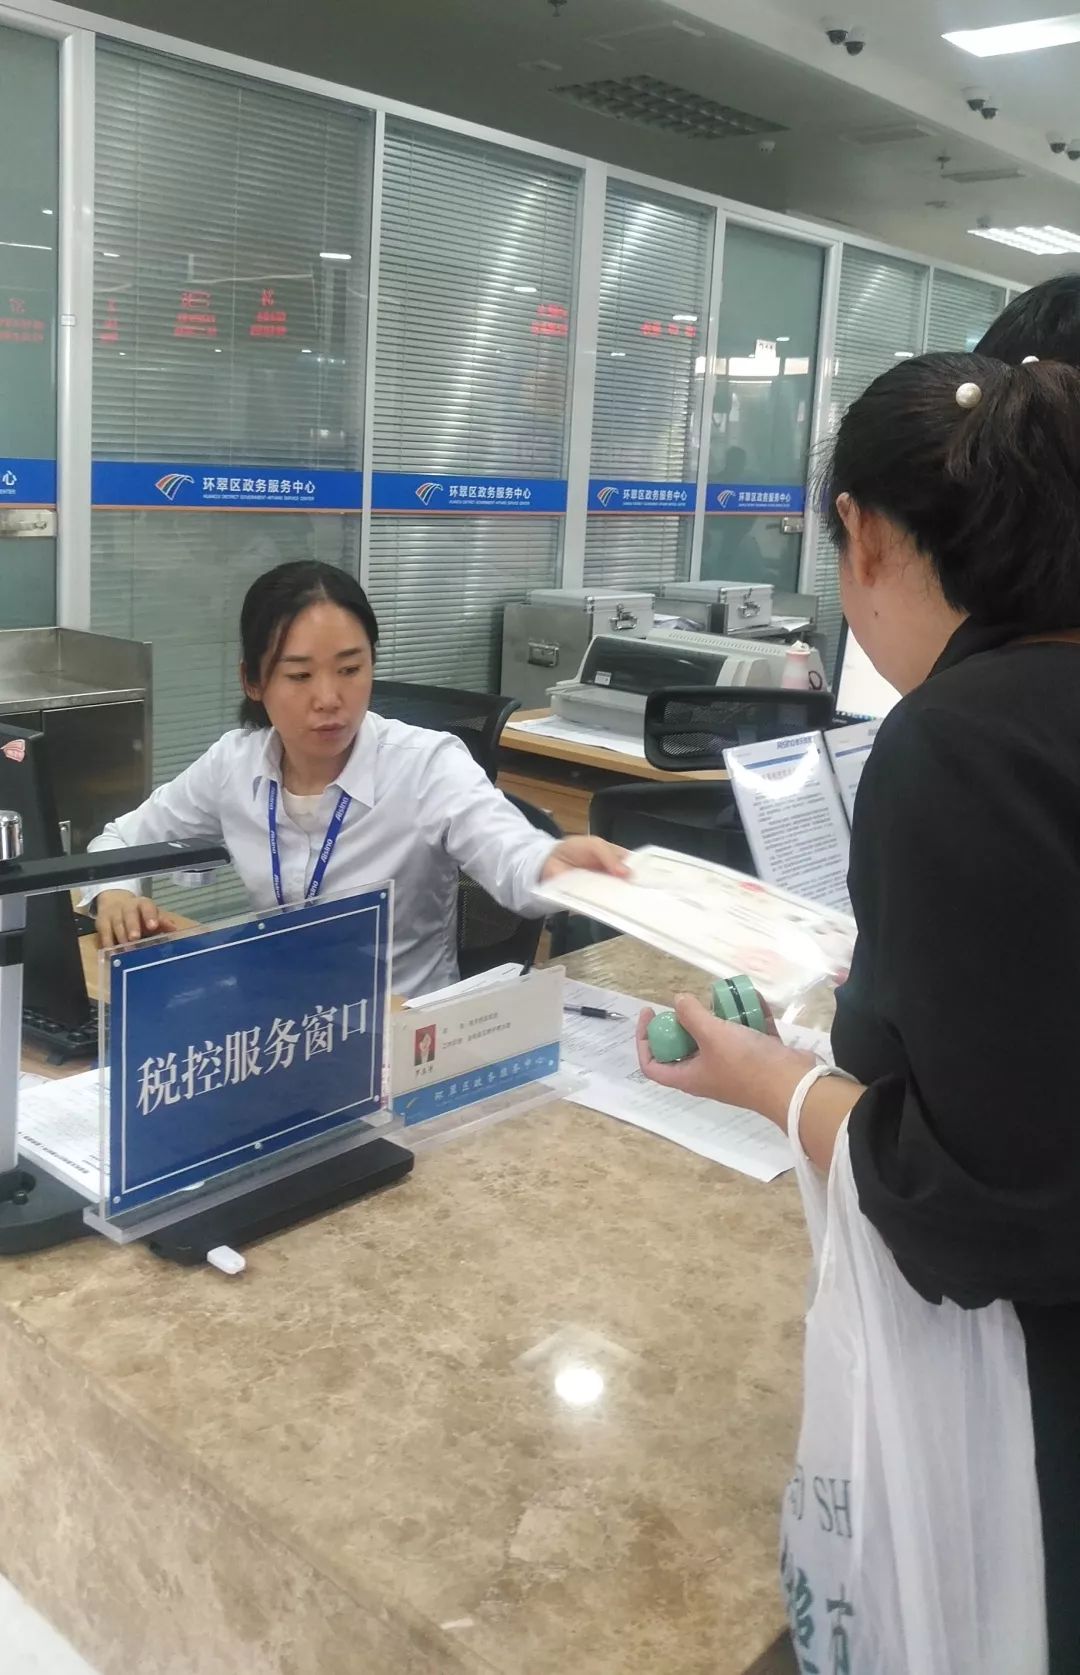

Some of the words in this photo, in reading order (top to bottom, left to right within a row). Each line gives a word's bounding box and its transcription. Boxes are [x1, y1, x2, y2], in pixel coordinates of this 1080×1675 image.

[203, 477, 316, 494] 环翠区政务服务中心
[449, 485, 531, 499] 环翠区政务服务中心
[623, 488, 688, 501] 环翠区政务服务中心
[320, 838, 333, 863] Aisino
[136, 998, 368, 1117] 税控服务窗口
